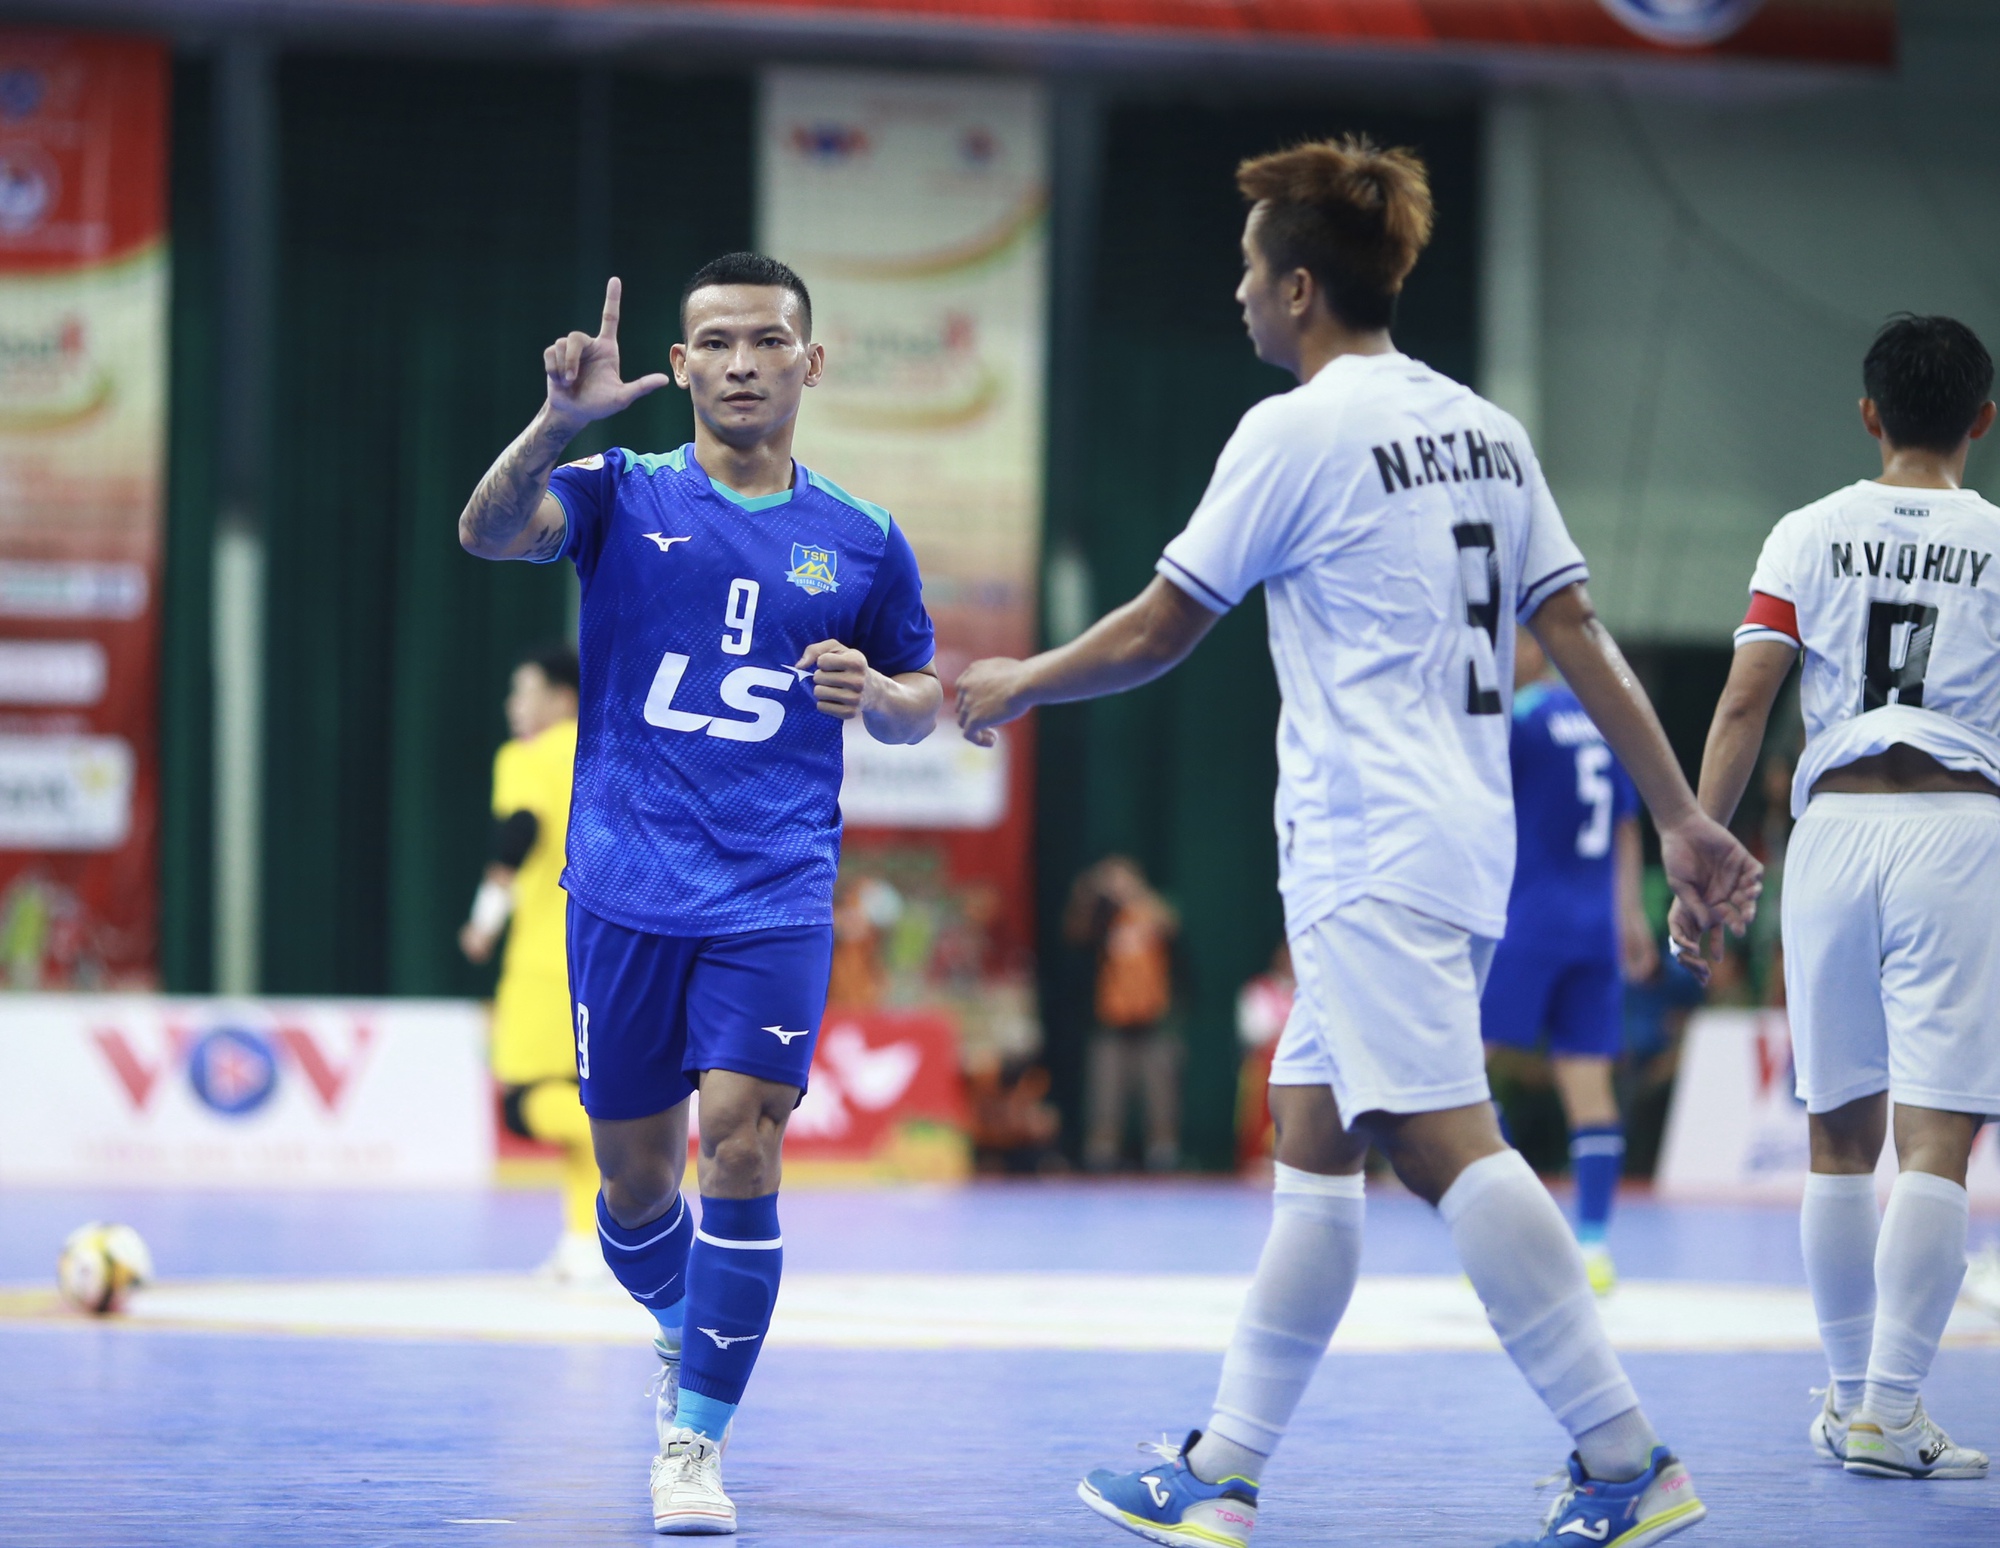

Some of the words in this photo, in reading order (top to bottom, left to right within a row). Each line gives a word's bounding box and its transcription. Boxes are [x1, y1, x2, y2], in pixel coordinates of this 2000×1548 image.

[801, 549, 828, 563] TSN
[721, 578, 760, 656] 9
[643, 651, 795, 742] LS
[1575, 743, 1613, 858] 5
[577, 1002, 589, 1080] 9
